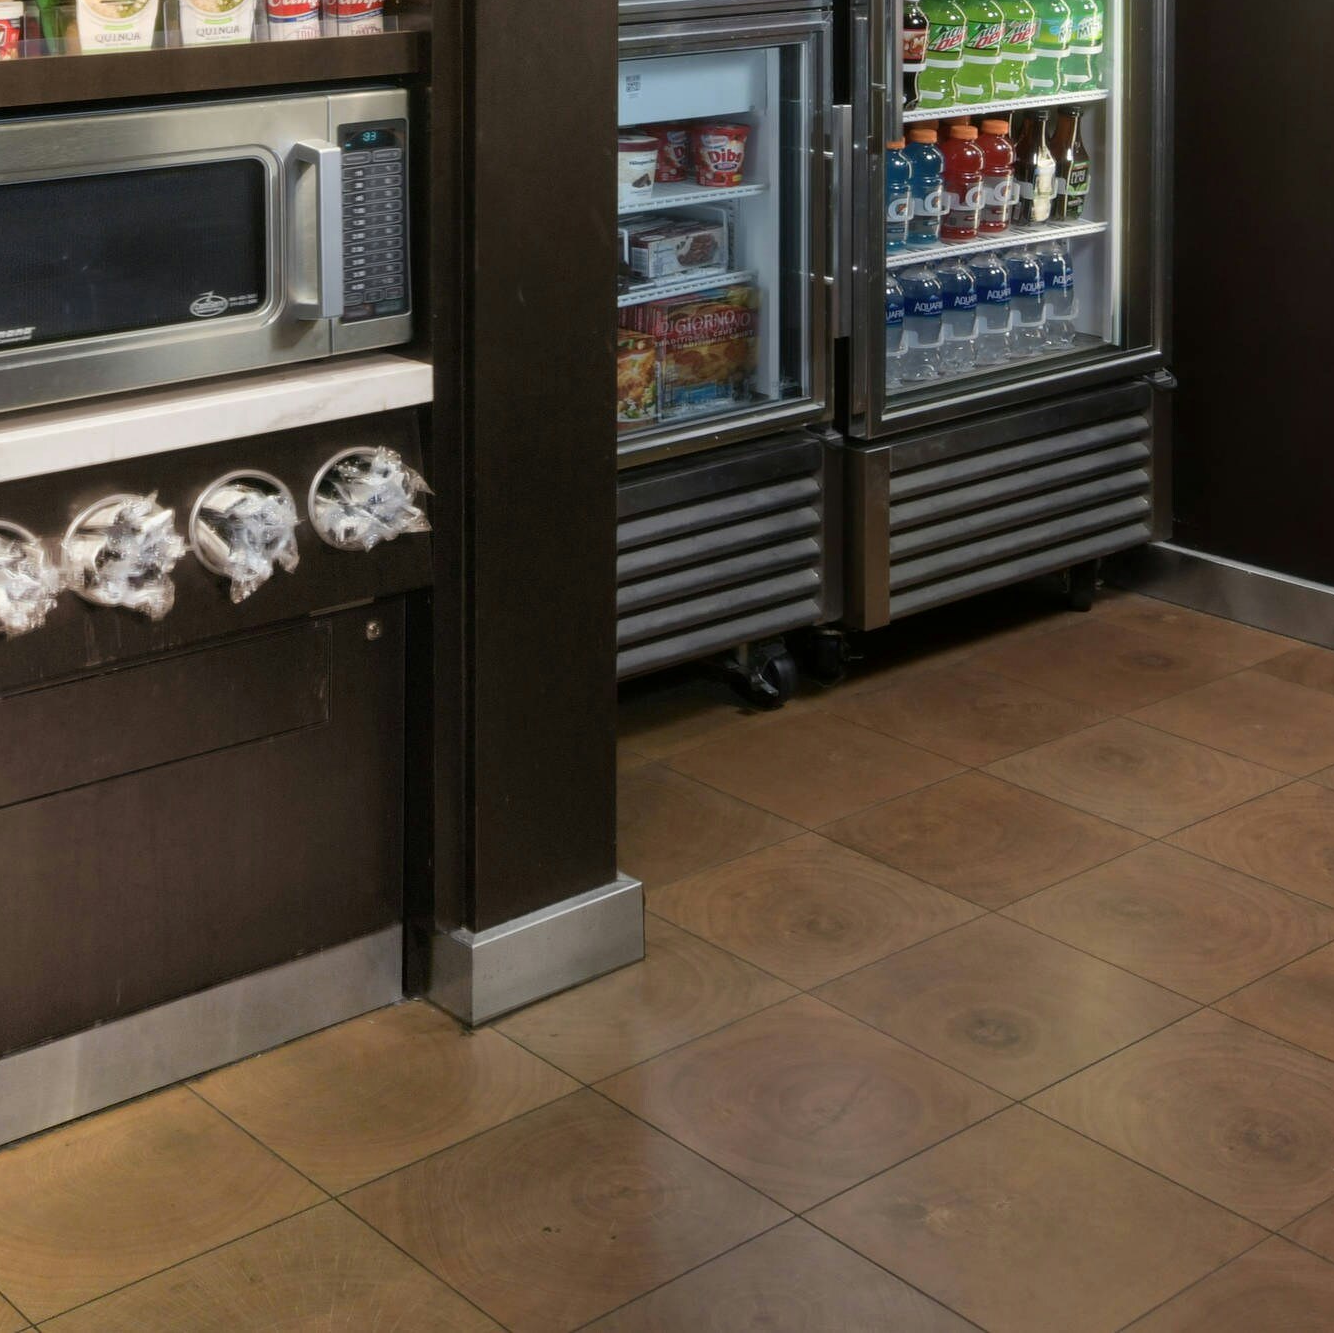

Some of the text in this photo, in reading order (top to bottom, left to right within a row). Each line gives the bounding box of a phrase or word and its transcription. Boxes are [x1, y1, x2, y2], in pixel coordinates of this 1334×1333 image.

[196, 25, 240, 37] QUINOA
[94, 32, 141, 43] QUINOA
[707, 148, 743, 164] Dibs
